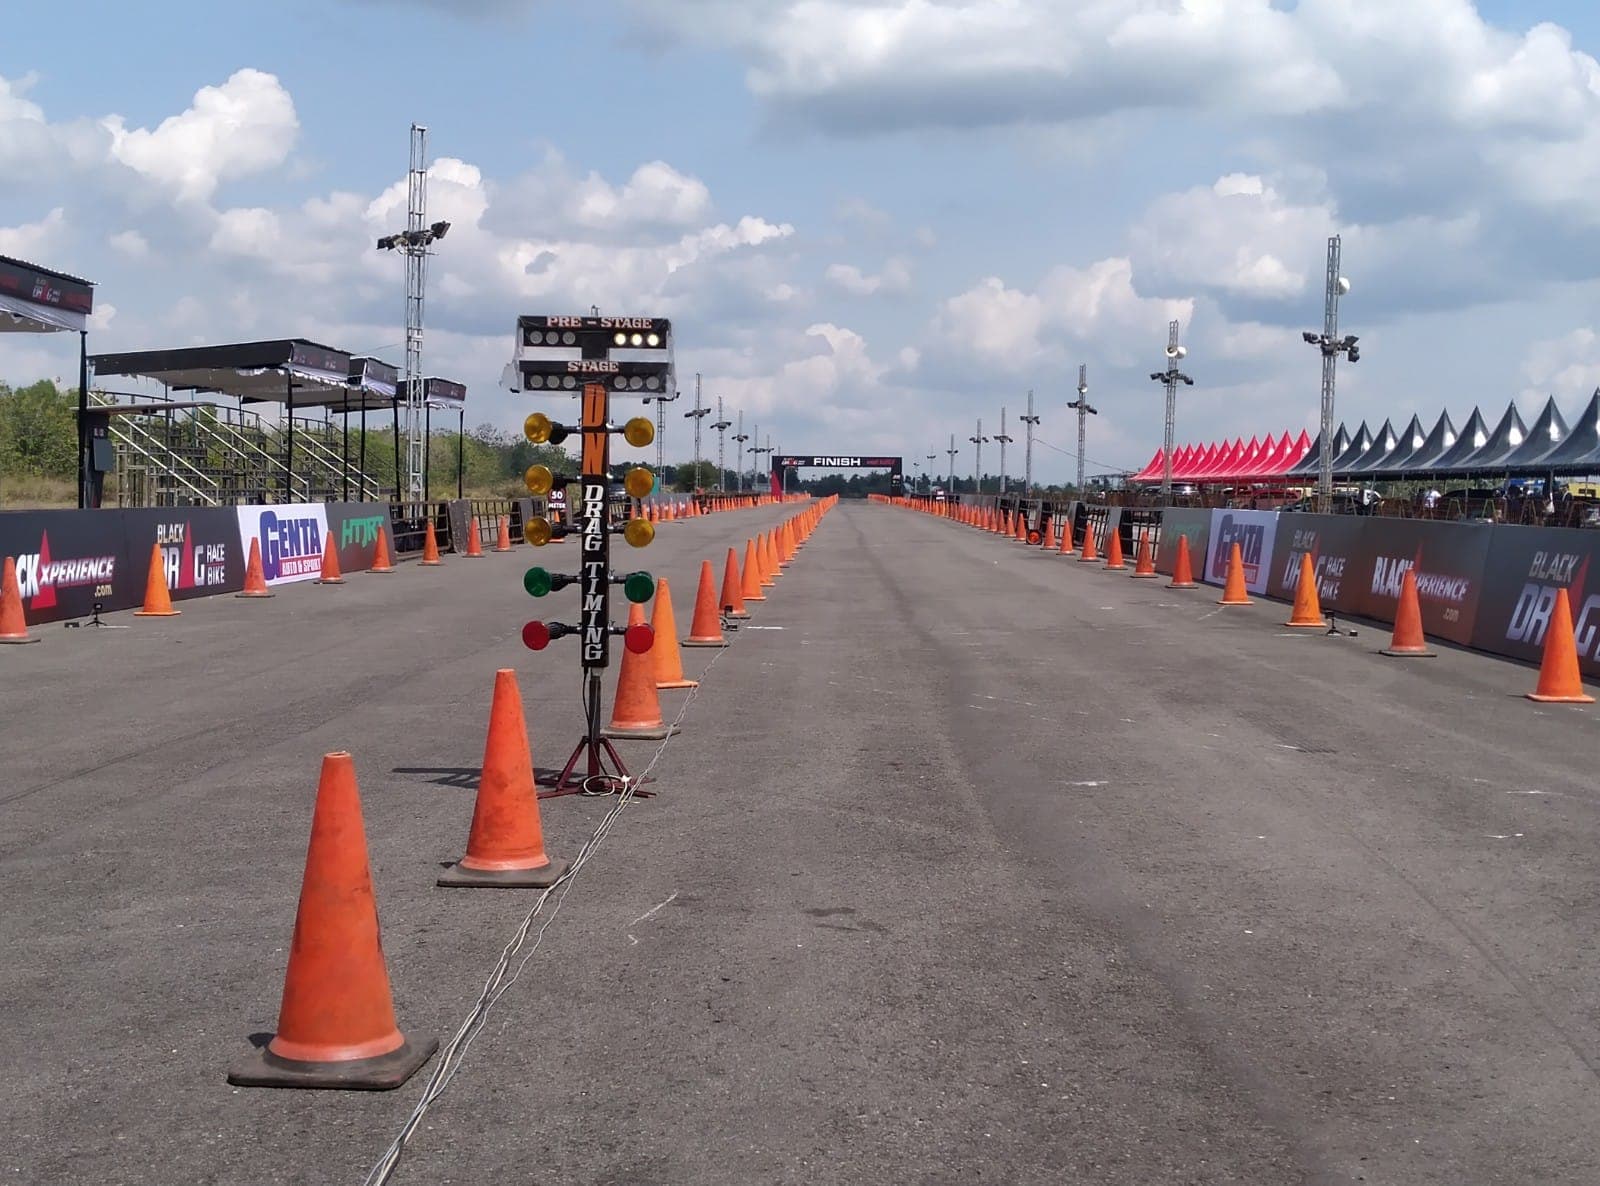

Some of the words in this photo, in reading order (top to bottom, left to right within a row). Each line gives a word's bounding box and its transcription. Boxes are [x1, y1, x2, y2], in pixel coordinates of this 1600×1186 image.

[546, 315, 582, 328] PRE
[600, 317, 653, 329] STAGE
[567, 360, 620, 373] STAGE
[813, 457, 861, 466] FINISH
[551, 490, 564, 500] 50
[583, 484, 604, 552] DRAG
[157, 523, 184, 544] BLACK
[206, 543, 225, 563] RACE
[259, 511, 322, 581] GENTA
[1211, 513, 1265, 580] GENTA
[39, 556, 116, 586] XPERIENCE
[207, 565, 225, 586] BIKE
[1325, 555, 1347, 577] RACE
[1528, 550, 1580, 583] BLACK
[94, 584, 113, 598] .com
[1320, 579, 1341, 601] BIKE
[1415, 572, 1470, 602] PERIENCE
[583, 561, 605, 661] TIMING
